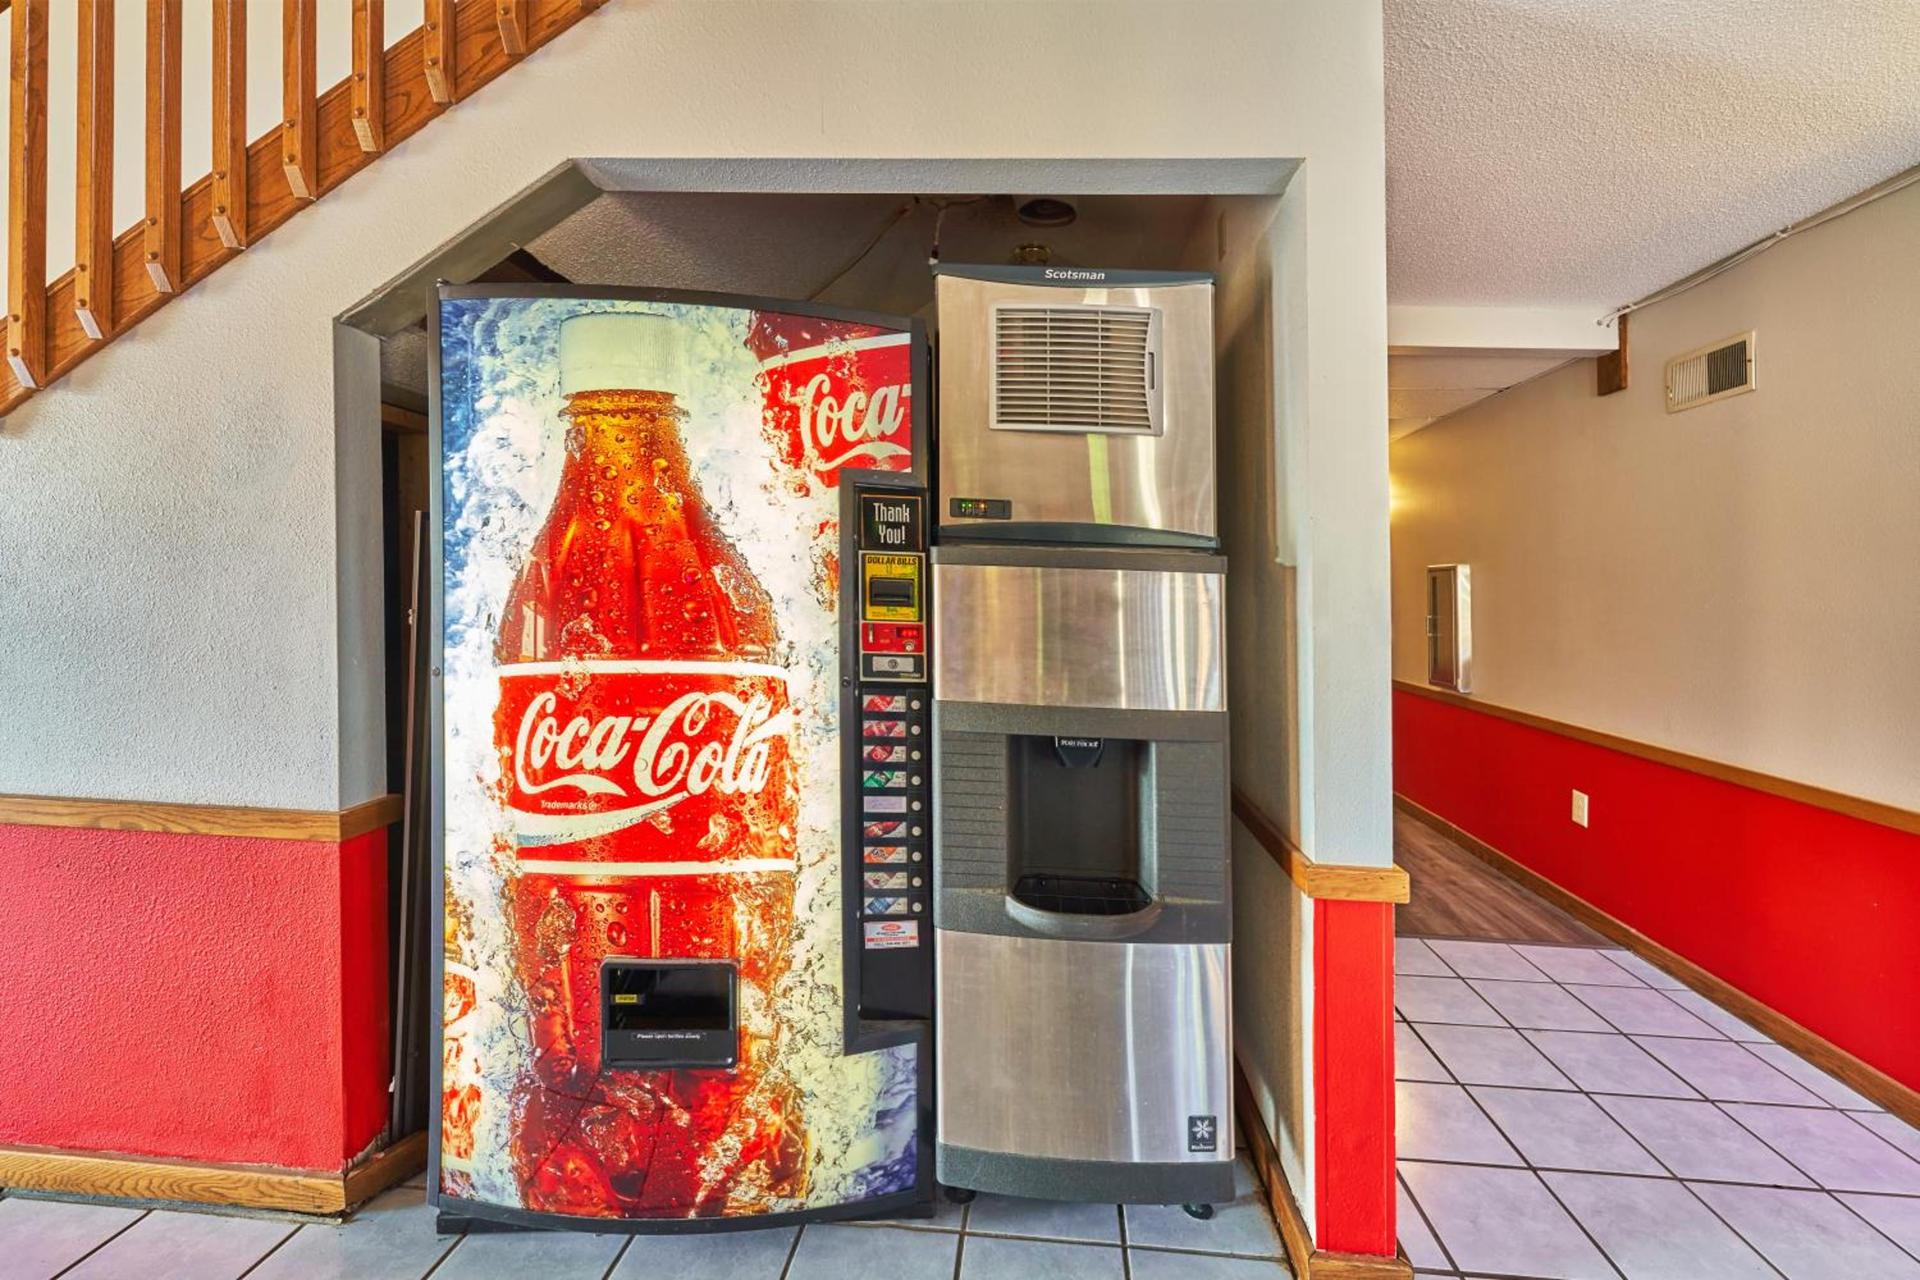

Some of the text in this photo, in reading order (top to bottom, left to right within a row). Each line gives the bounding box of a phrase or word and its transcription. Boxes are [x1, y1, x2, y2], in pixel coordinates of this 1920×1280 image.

[1044, 268, 1106, 280] Scotsman
[872, 502, 910, 523] Thank
[878, 524, 906, 544] You!
[867, 556, 917, 566] DOLLAR BILLS
[515, 691, 790, 798] Coca-Cola
